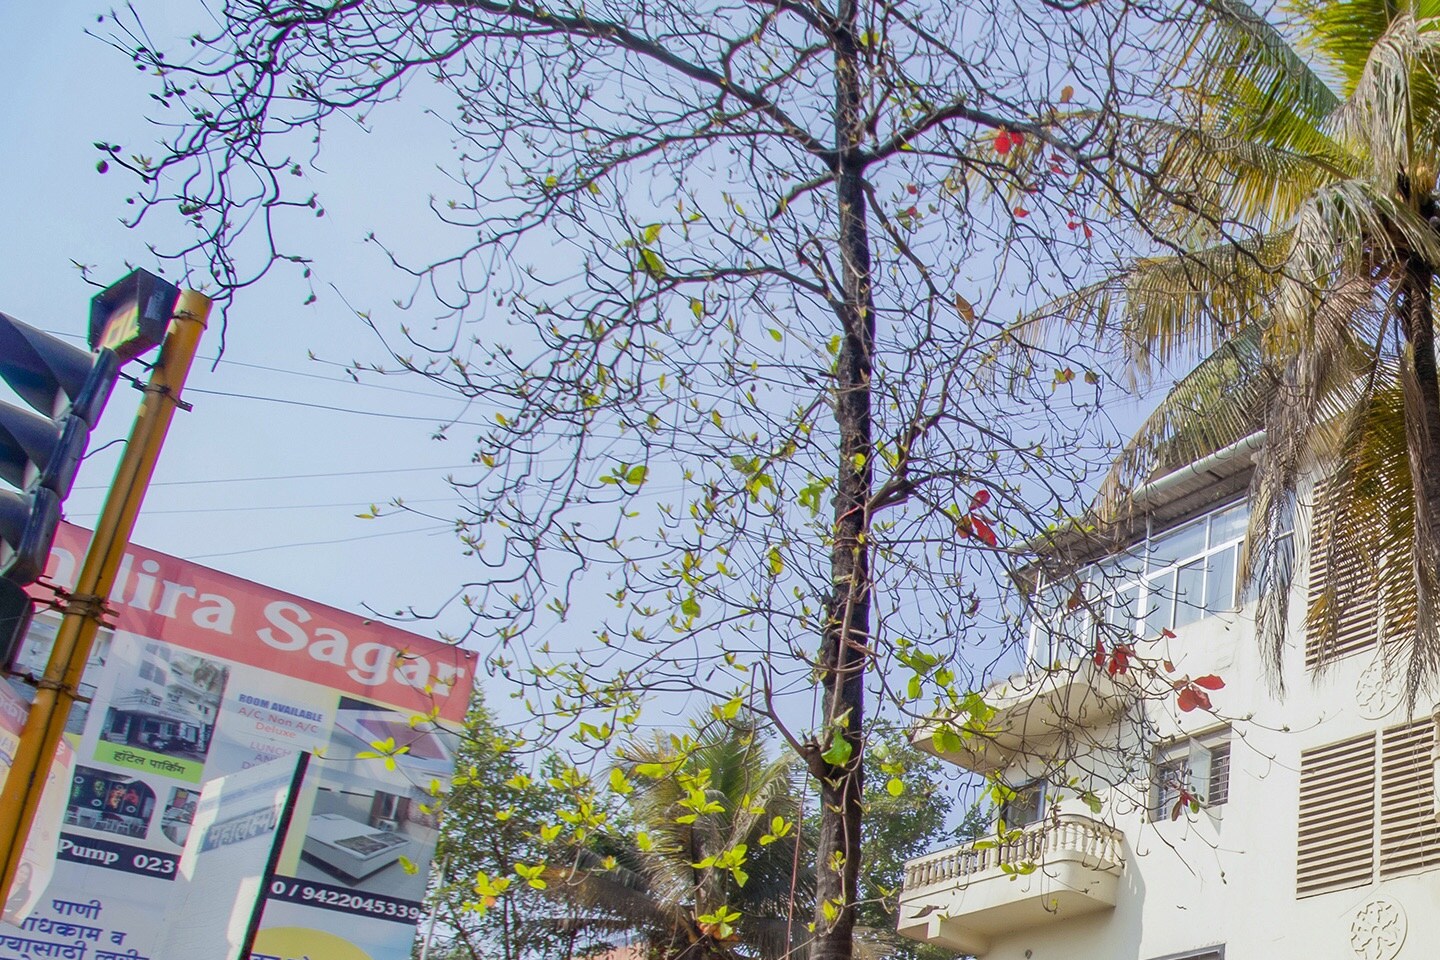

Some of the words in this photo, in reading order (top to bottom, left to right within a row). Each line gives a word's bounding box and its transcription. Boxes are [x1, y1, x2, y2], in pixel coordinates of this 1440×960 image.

[45, 547, 236, 635] nira
[256, 601, 465, 697] Sagar
[239, 693, 270, 709] ROOM
[270, 702, 323, 723] AVAILABLE
[255, 721, 297, 739] Deluxe
[268, 714, 292, 727] Non
[295, 721, 319, 734] A/C
[113, 750, 146, 766] हॉटेल
[250, 741, 292, 757] LUNCH
[58, 838, 120, 865] Pump
[133, 853, 177, 875] 023
[53, 899, 102, 920] पाणी
[302, 886, 420, 920] 9422045339
[22, 911, 103, 942] ांधकाम
[110, 930, 128, 946] व
